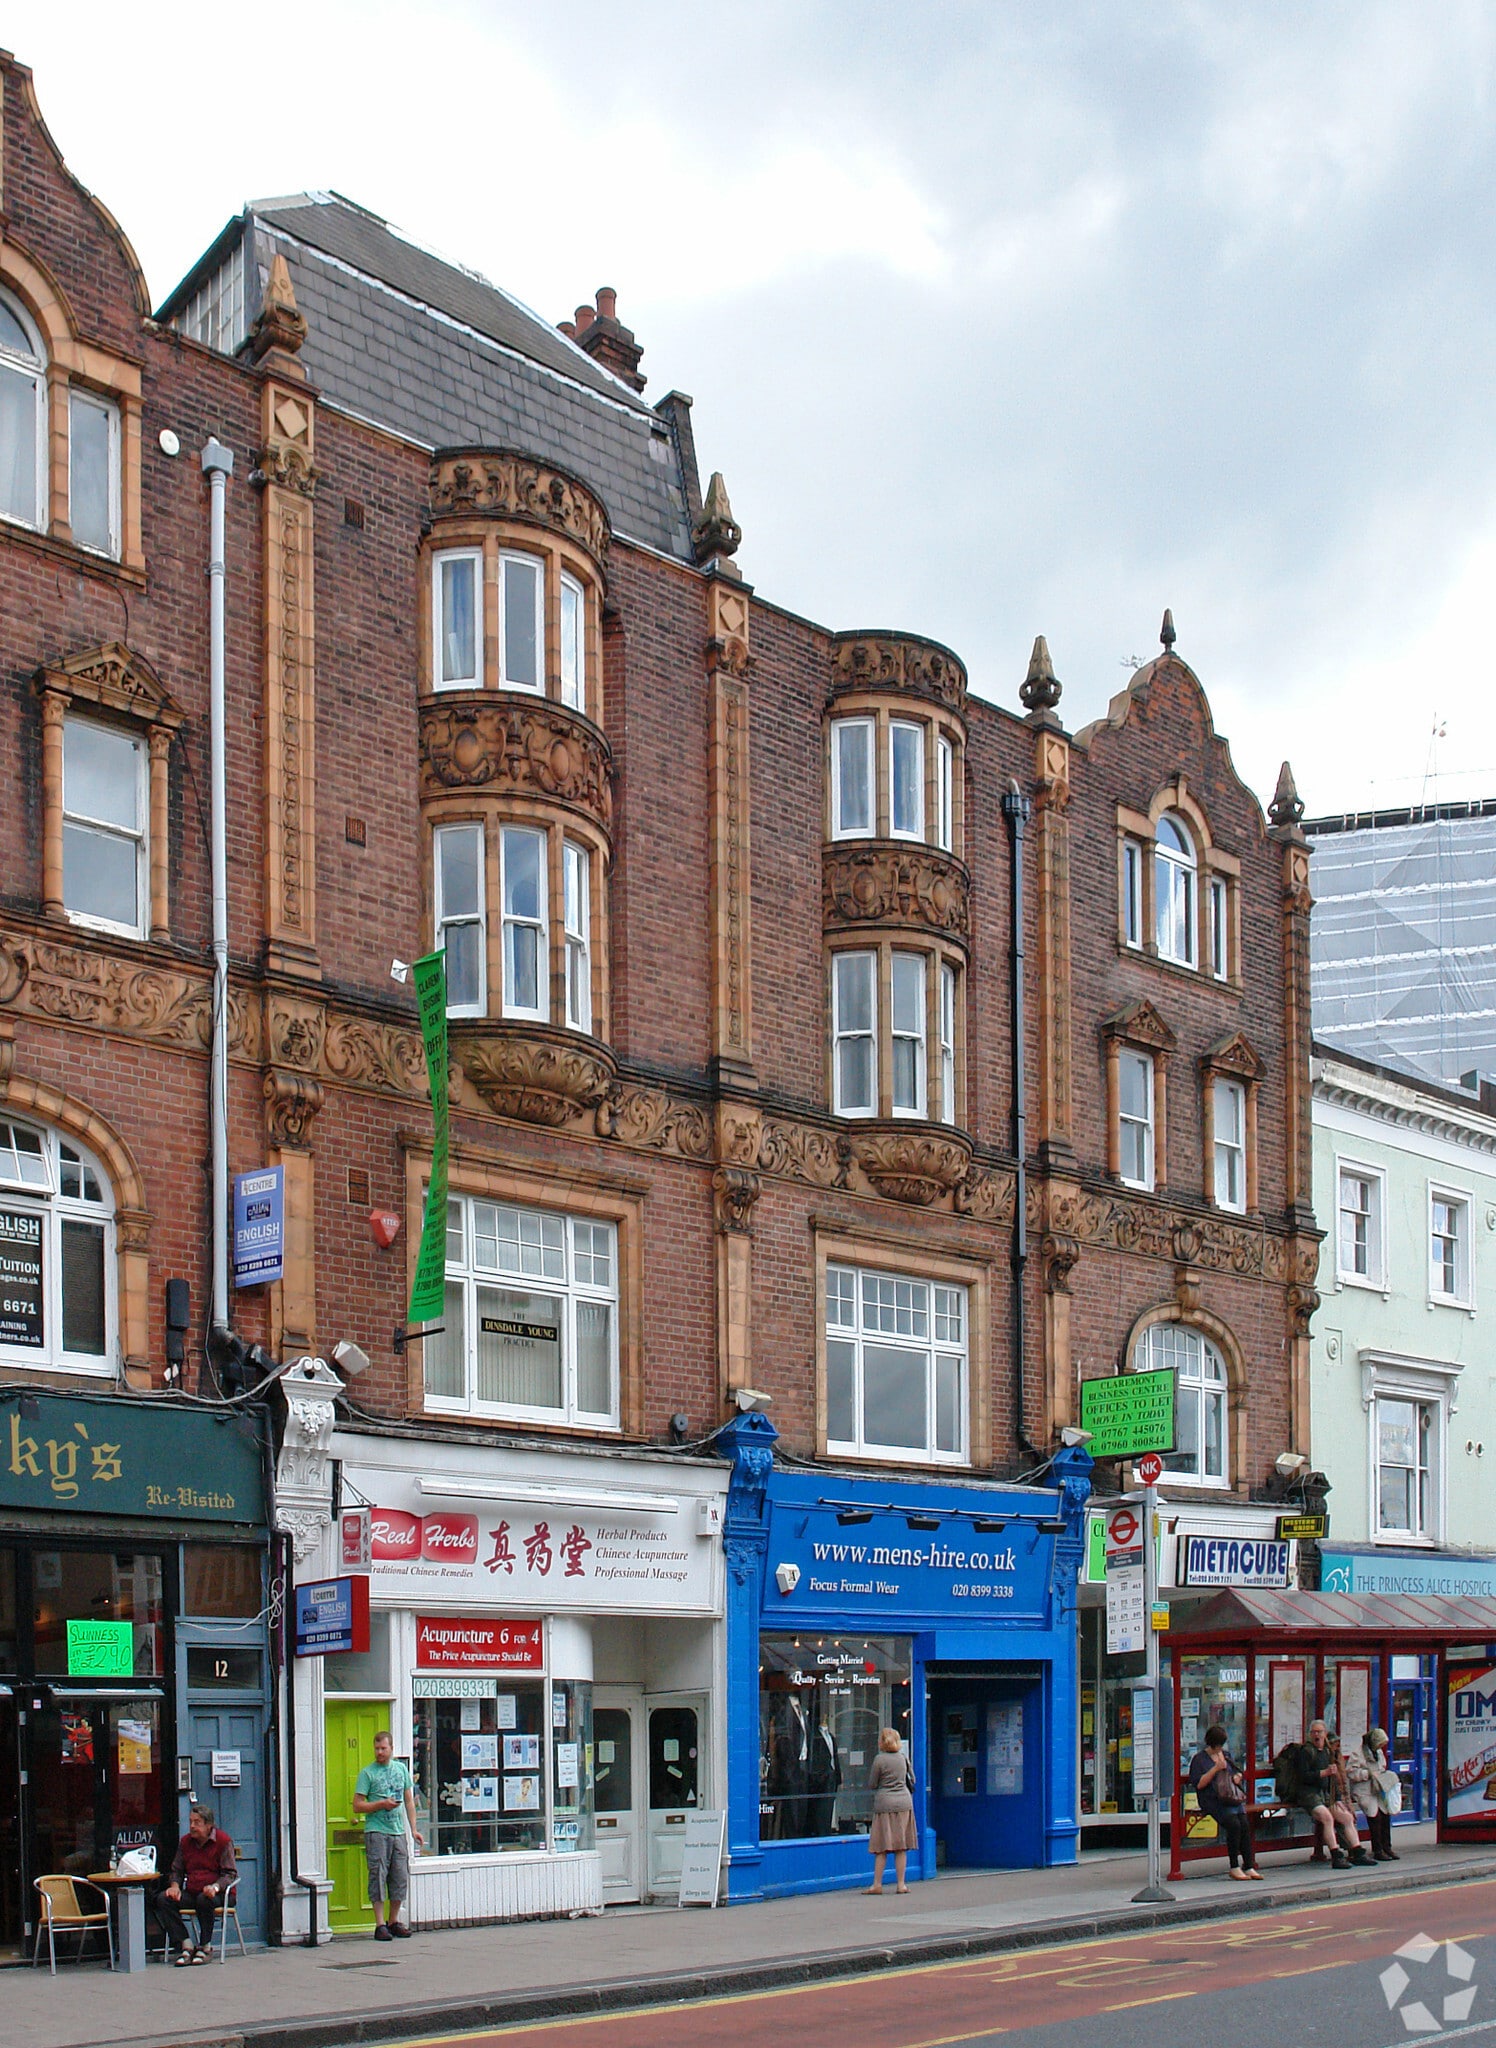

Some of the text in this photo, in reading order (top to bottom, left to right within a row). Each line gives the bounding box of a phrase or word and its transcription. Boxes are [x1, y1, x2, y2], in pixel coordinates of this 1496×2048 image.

[237, 1222, 280, 1243] ENGLISH
[3, 1299, 36, 1315] 6671
[485, 1320, 554, 1338] DINSDALE YOUNG
[1100, 1375, 1157, 1390] CLAREMONT
[1088, 1383, 1170, 1401] BUSINESS CENTRE
[1086, 1395, 1172, 1415] OFFICES TO LET
[1092, 1408, 1167, 1425] MOVE IN TODAY
[1101, 1427, 1128, 1438] 07767
[1132, 1423, 1166, 1435] 445076
[1101, 1440, 1128, 1451] 07960
[1132, 1436, 1166, 1448] 800844
[1141, 1461, 1158, 1475] NK
[146, 1485, 235, 1510] Re-Visited
[370, 1521, 416, 1545] Real
[425, 1525, 476, 1548] Herbs
[596, 1528, 667, 1541] Herbal Products
[483, 1520, 592, 1577] 真药堂
[595, 1547, 688, 1562] Chinese Acupuncture
[813, 1542, 1016, 1571] www.mens-hire.co.uk
[1190, 1539, 1287, 1575] METACUBE
[410, 1566, 438, 1577] Chinese
[441, 1568, 473, 1578] Remedies
[594, 1566, 688, 1582] Professional Massage
[809, 1577, 1014, 1598] Focus Formal Wear 020 8399 3338
[1357, 1576, 1492, 1595] THE PRINCESS ALICE HOSPICE
[319, 1601, 347, 1615] ENGLISH
[420, 1625, 539, 1645] Acupuncture 6 FOR 4
[429, 1650, 532, 1662] The Price Acupuncture Should Be
[817, 1654, 864, 1667] Getting Married
[215, 1660, 228, 1677] 12
[794, 1670, 881, 1686] Quality Service Reputation
[414, 1679, 497, 1697] 02083993311
[347, 1738, 357, 1748] 10
[1453, 1756, 1479, 1788] KitKat
[759, 1803, 774, 1814] Hire
[134, 1830, 153, 1844] DAY
